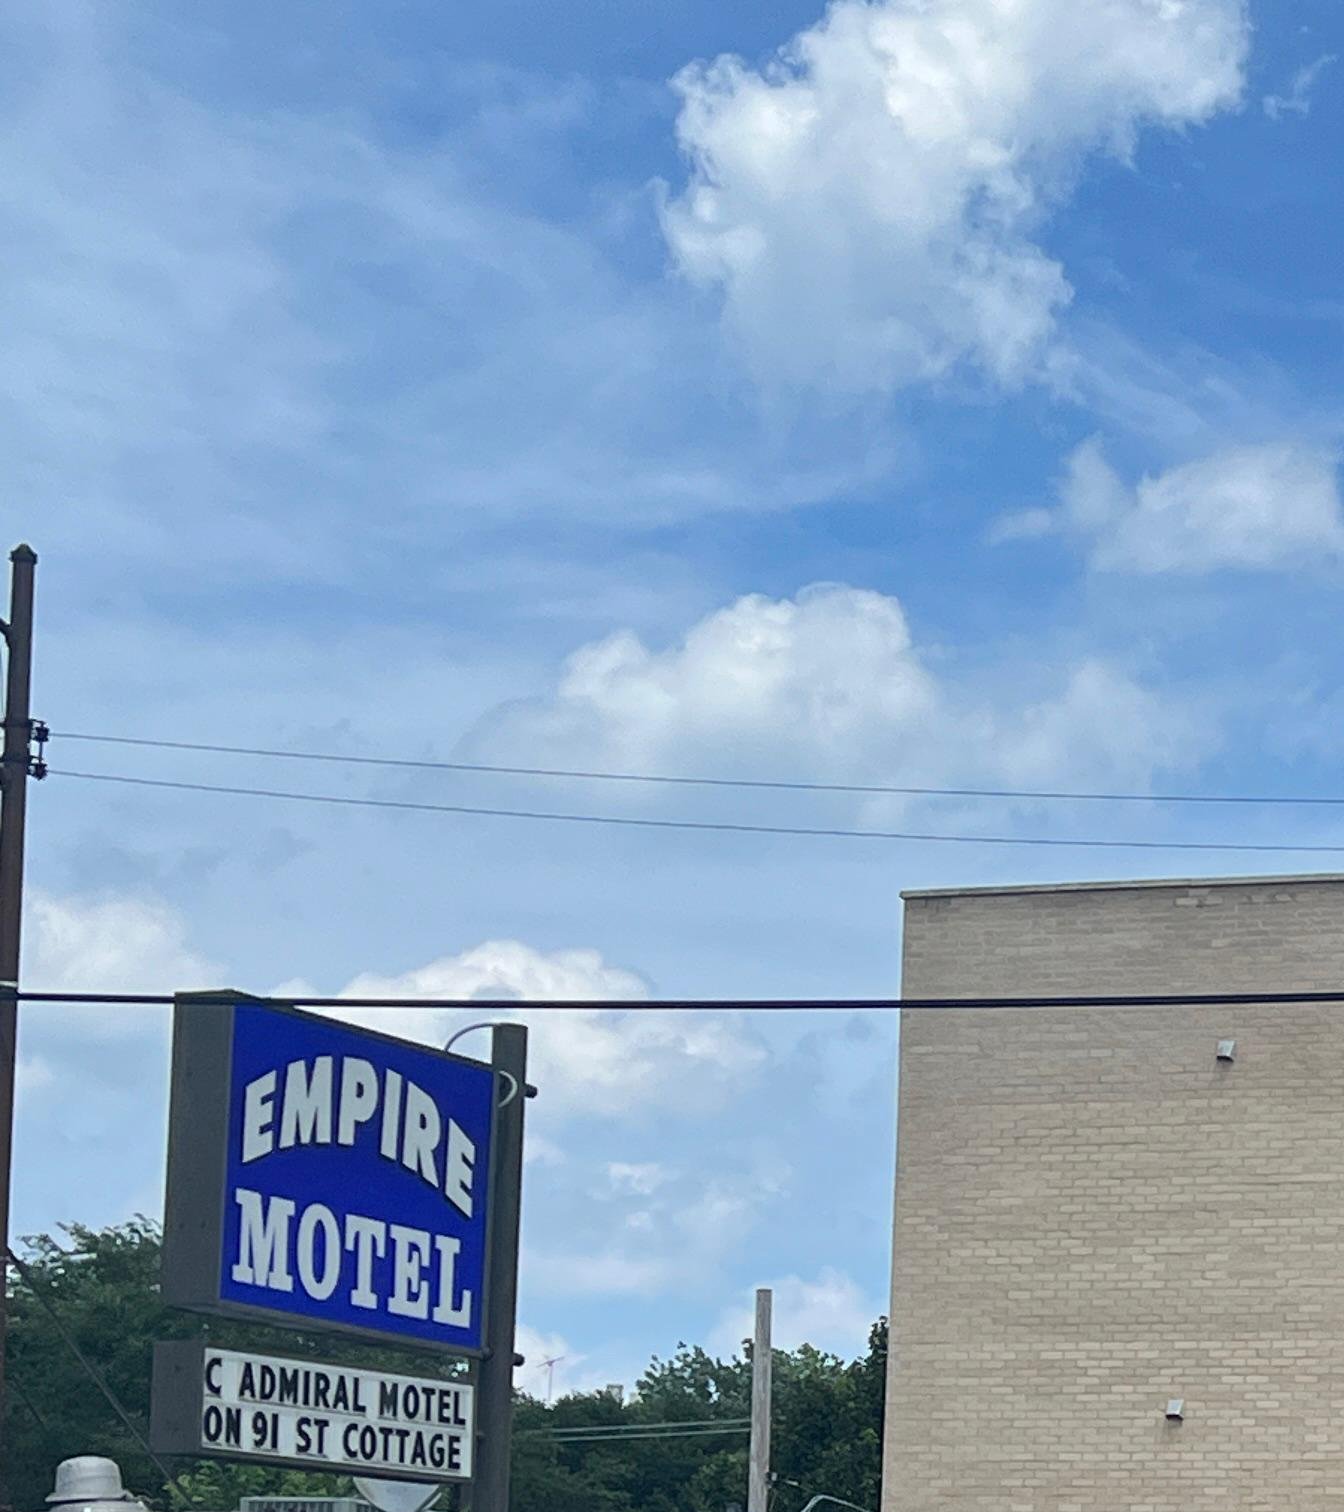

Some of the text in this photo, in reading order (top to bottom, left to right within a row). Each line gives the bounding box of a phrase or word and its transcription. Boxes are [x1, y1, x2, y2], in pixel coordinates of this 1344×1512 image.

[242, 1056, 476, 1219] EMPIRE
[232, 1188, 472, 1329] MOTEL
[204, 1405, 461, 1470] ON 91 ST COTTAGE
[205, 1357, 466, 1426] C ADMIRAL MOTEL
